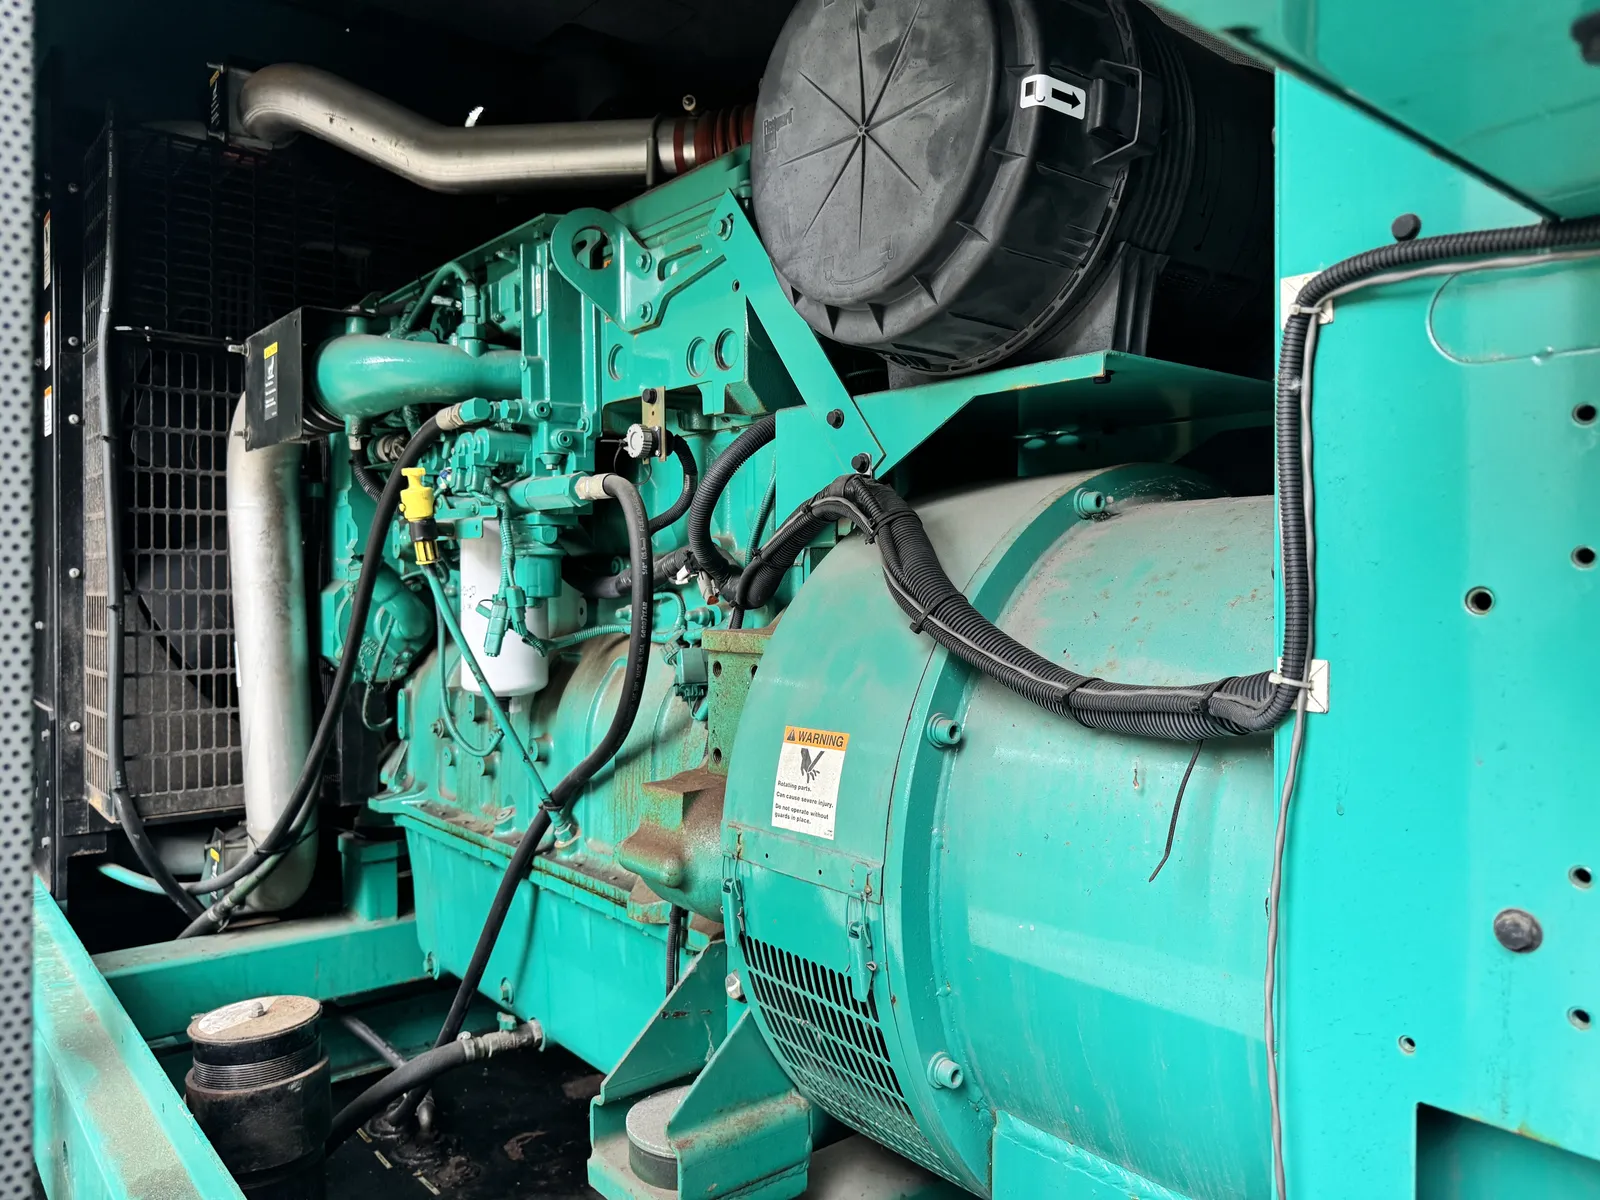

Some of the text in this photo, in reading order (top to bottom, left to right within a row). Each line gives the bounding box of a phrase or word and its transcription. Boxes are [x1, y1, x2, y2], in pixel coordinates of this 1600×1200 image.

[798, 730, 844, 748] WARNING
[778, 780, 797, 790] Rotating
[818, 799, 834, 808] injury.
[774, 812, 790, 820] guards
[791, 807, 809, 815] operate
[810, 811, 829, 820] without
